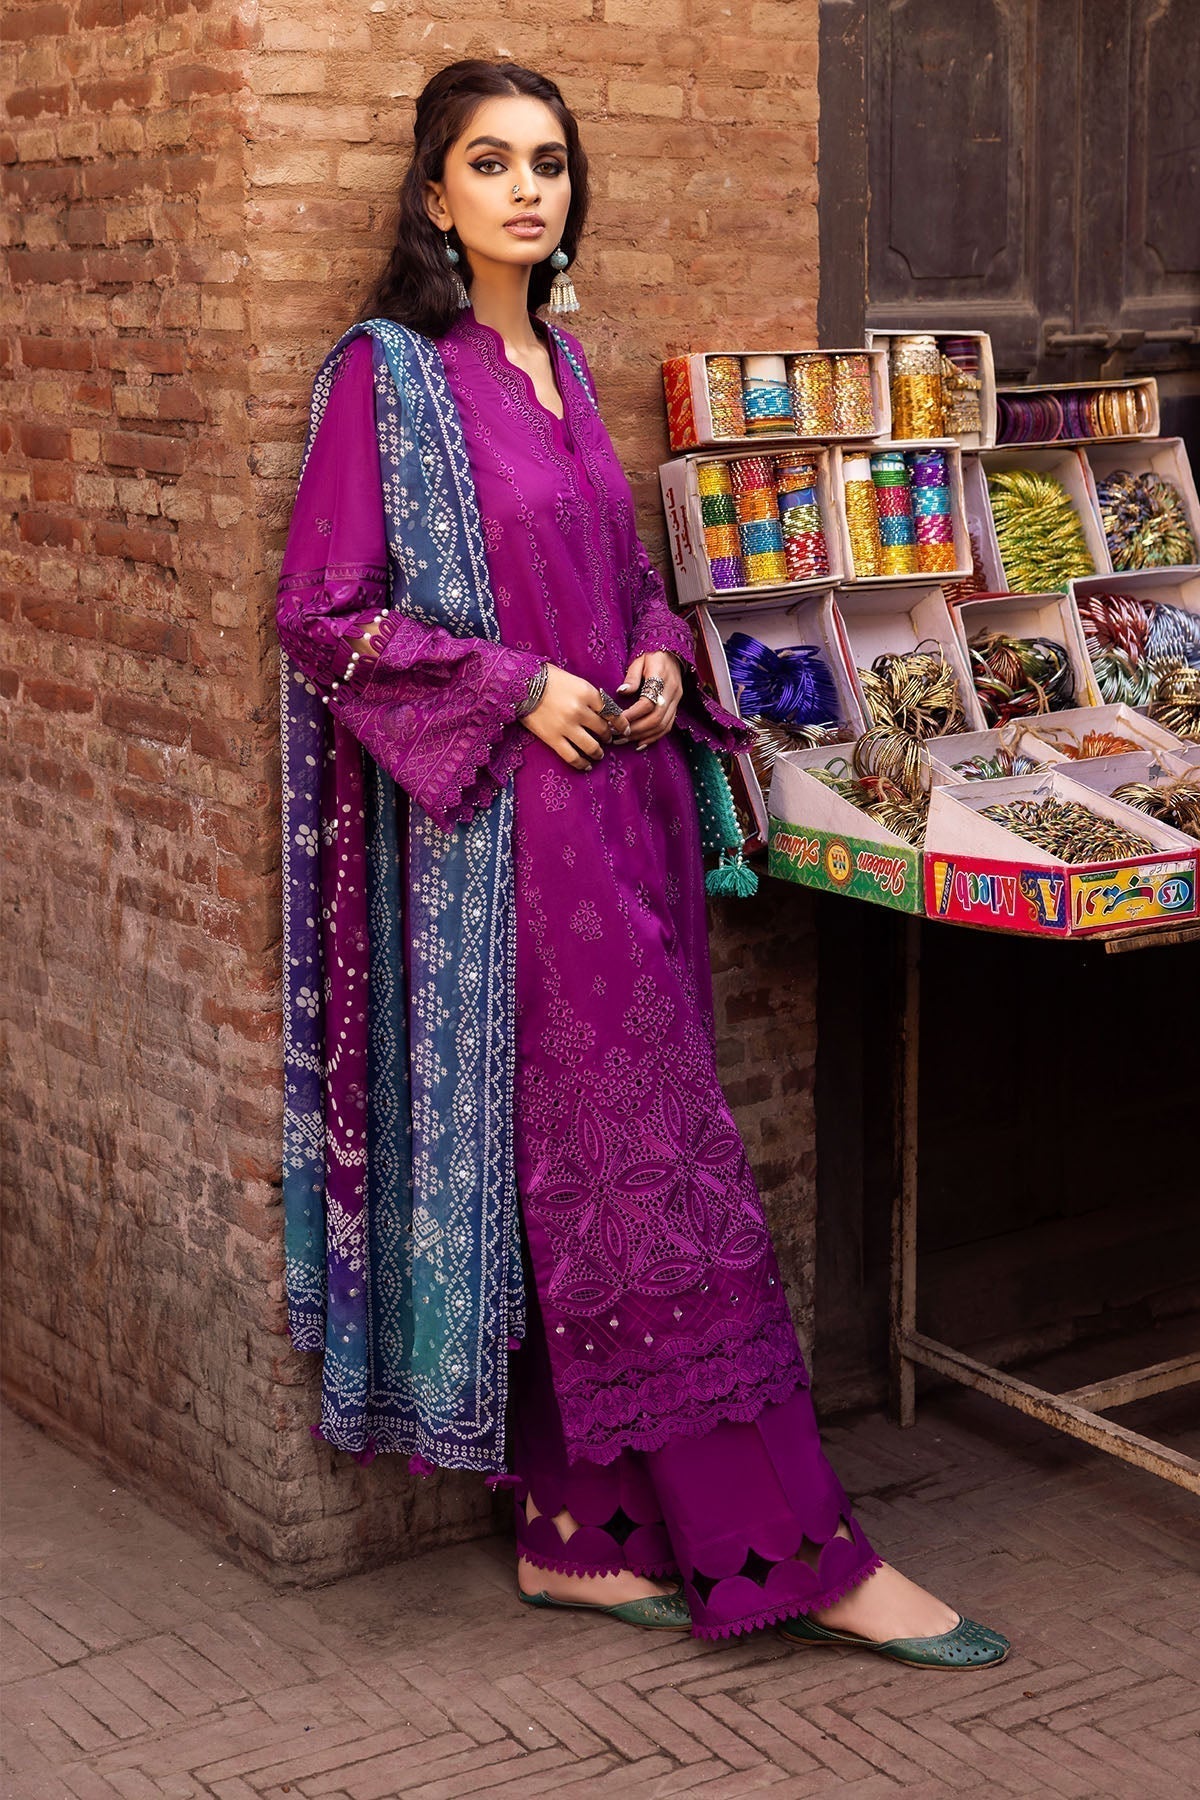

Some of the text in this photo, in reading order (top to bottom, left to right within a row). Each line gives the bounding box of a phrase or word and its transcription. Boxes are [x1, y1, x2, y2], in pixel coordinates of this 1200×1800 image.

[774, 832, 821, 867] Adnan
[857, 850, 907, 896] Nadeem
[954, 871, 1017, 917] Adeeb
